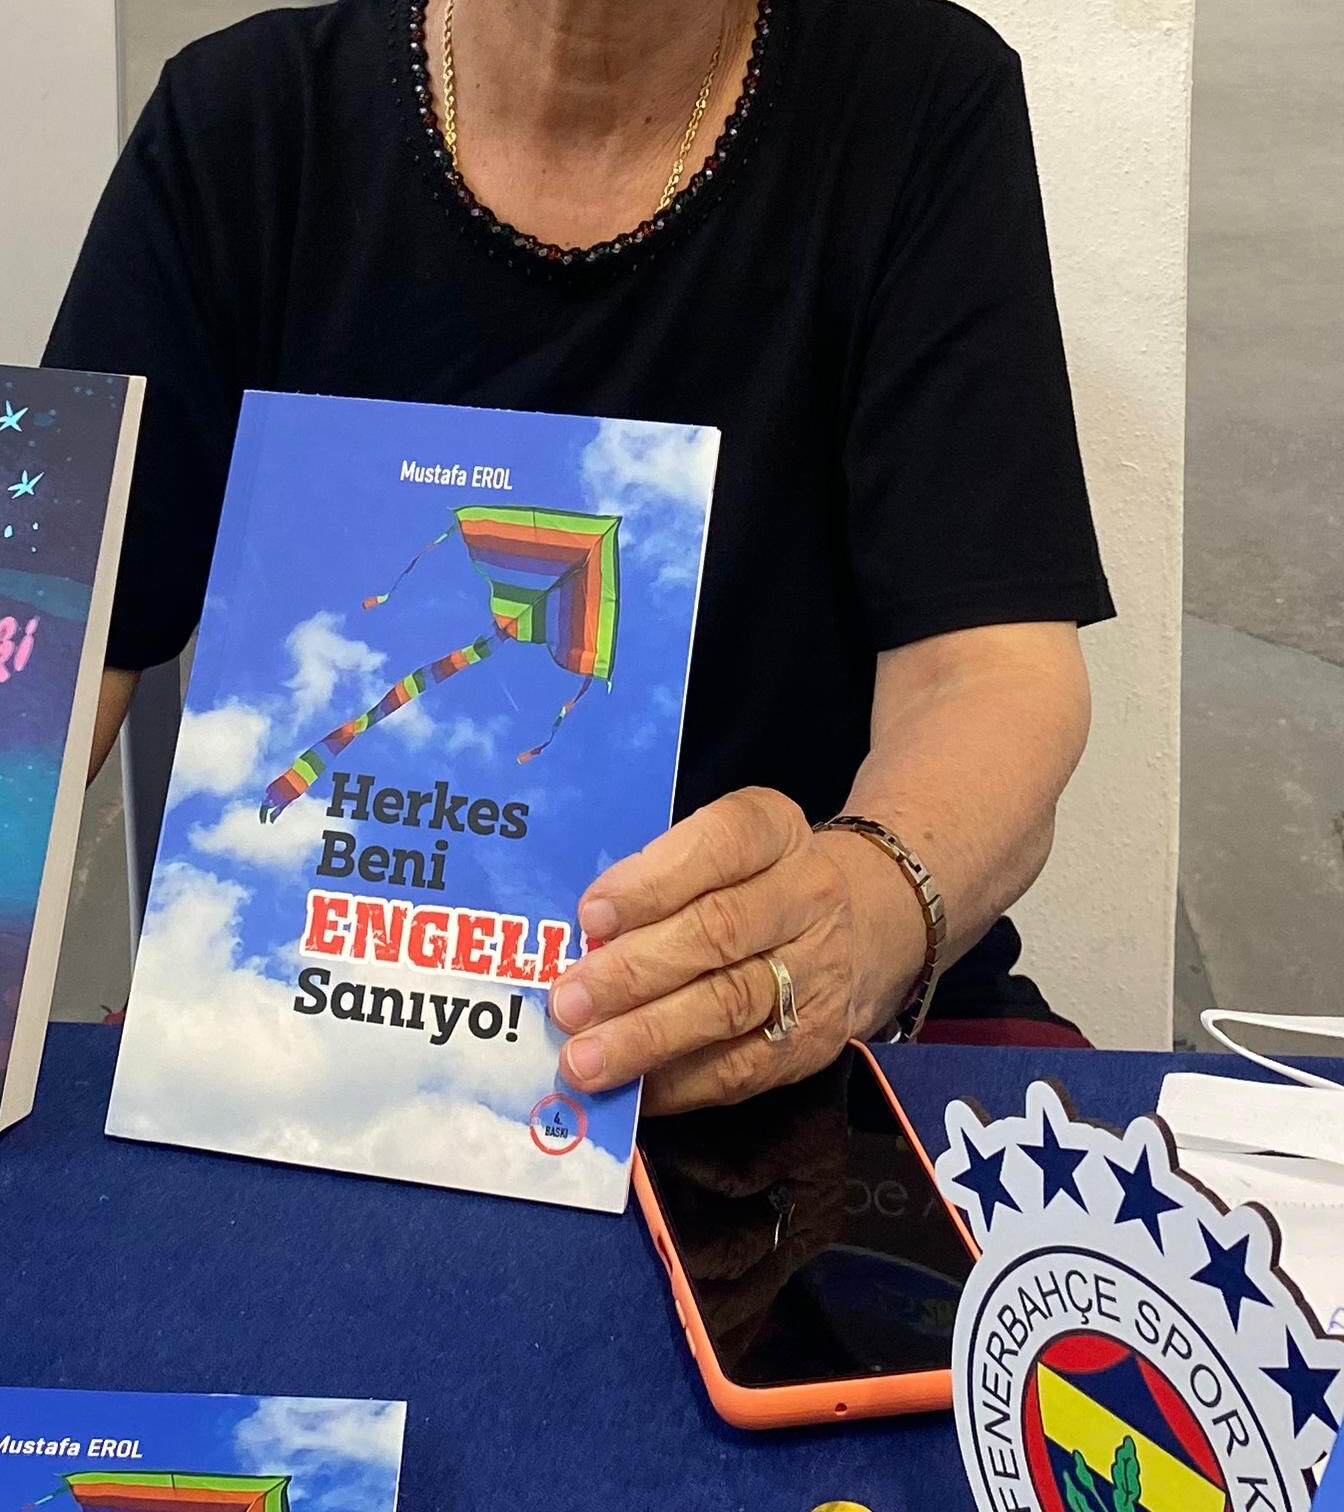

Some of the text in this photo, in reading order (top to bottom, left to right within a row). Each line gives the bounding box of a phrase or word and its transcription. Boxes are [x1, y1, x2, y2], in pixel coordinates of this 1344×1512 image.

[400, 459, 513, 490] Mustafa EROL
[326, 772, 529, 839] Herkes
[316, 830, 449, 890] Beni
[293, 967, 523, 1046] Sanıyo!
[982, 1270, 1121, 1512] FENERBAHÇE
[1134, 1300, 1250, 1457] SPOR
[87, 1438, 143, 1460] EROL
